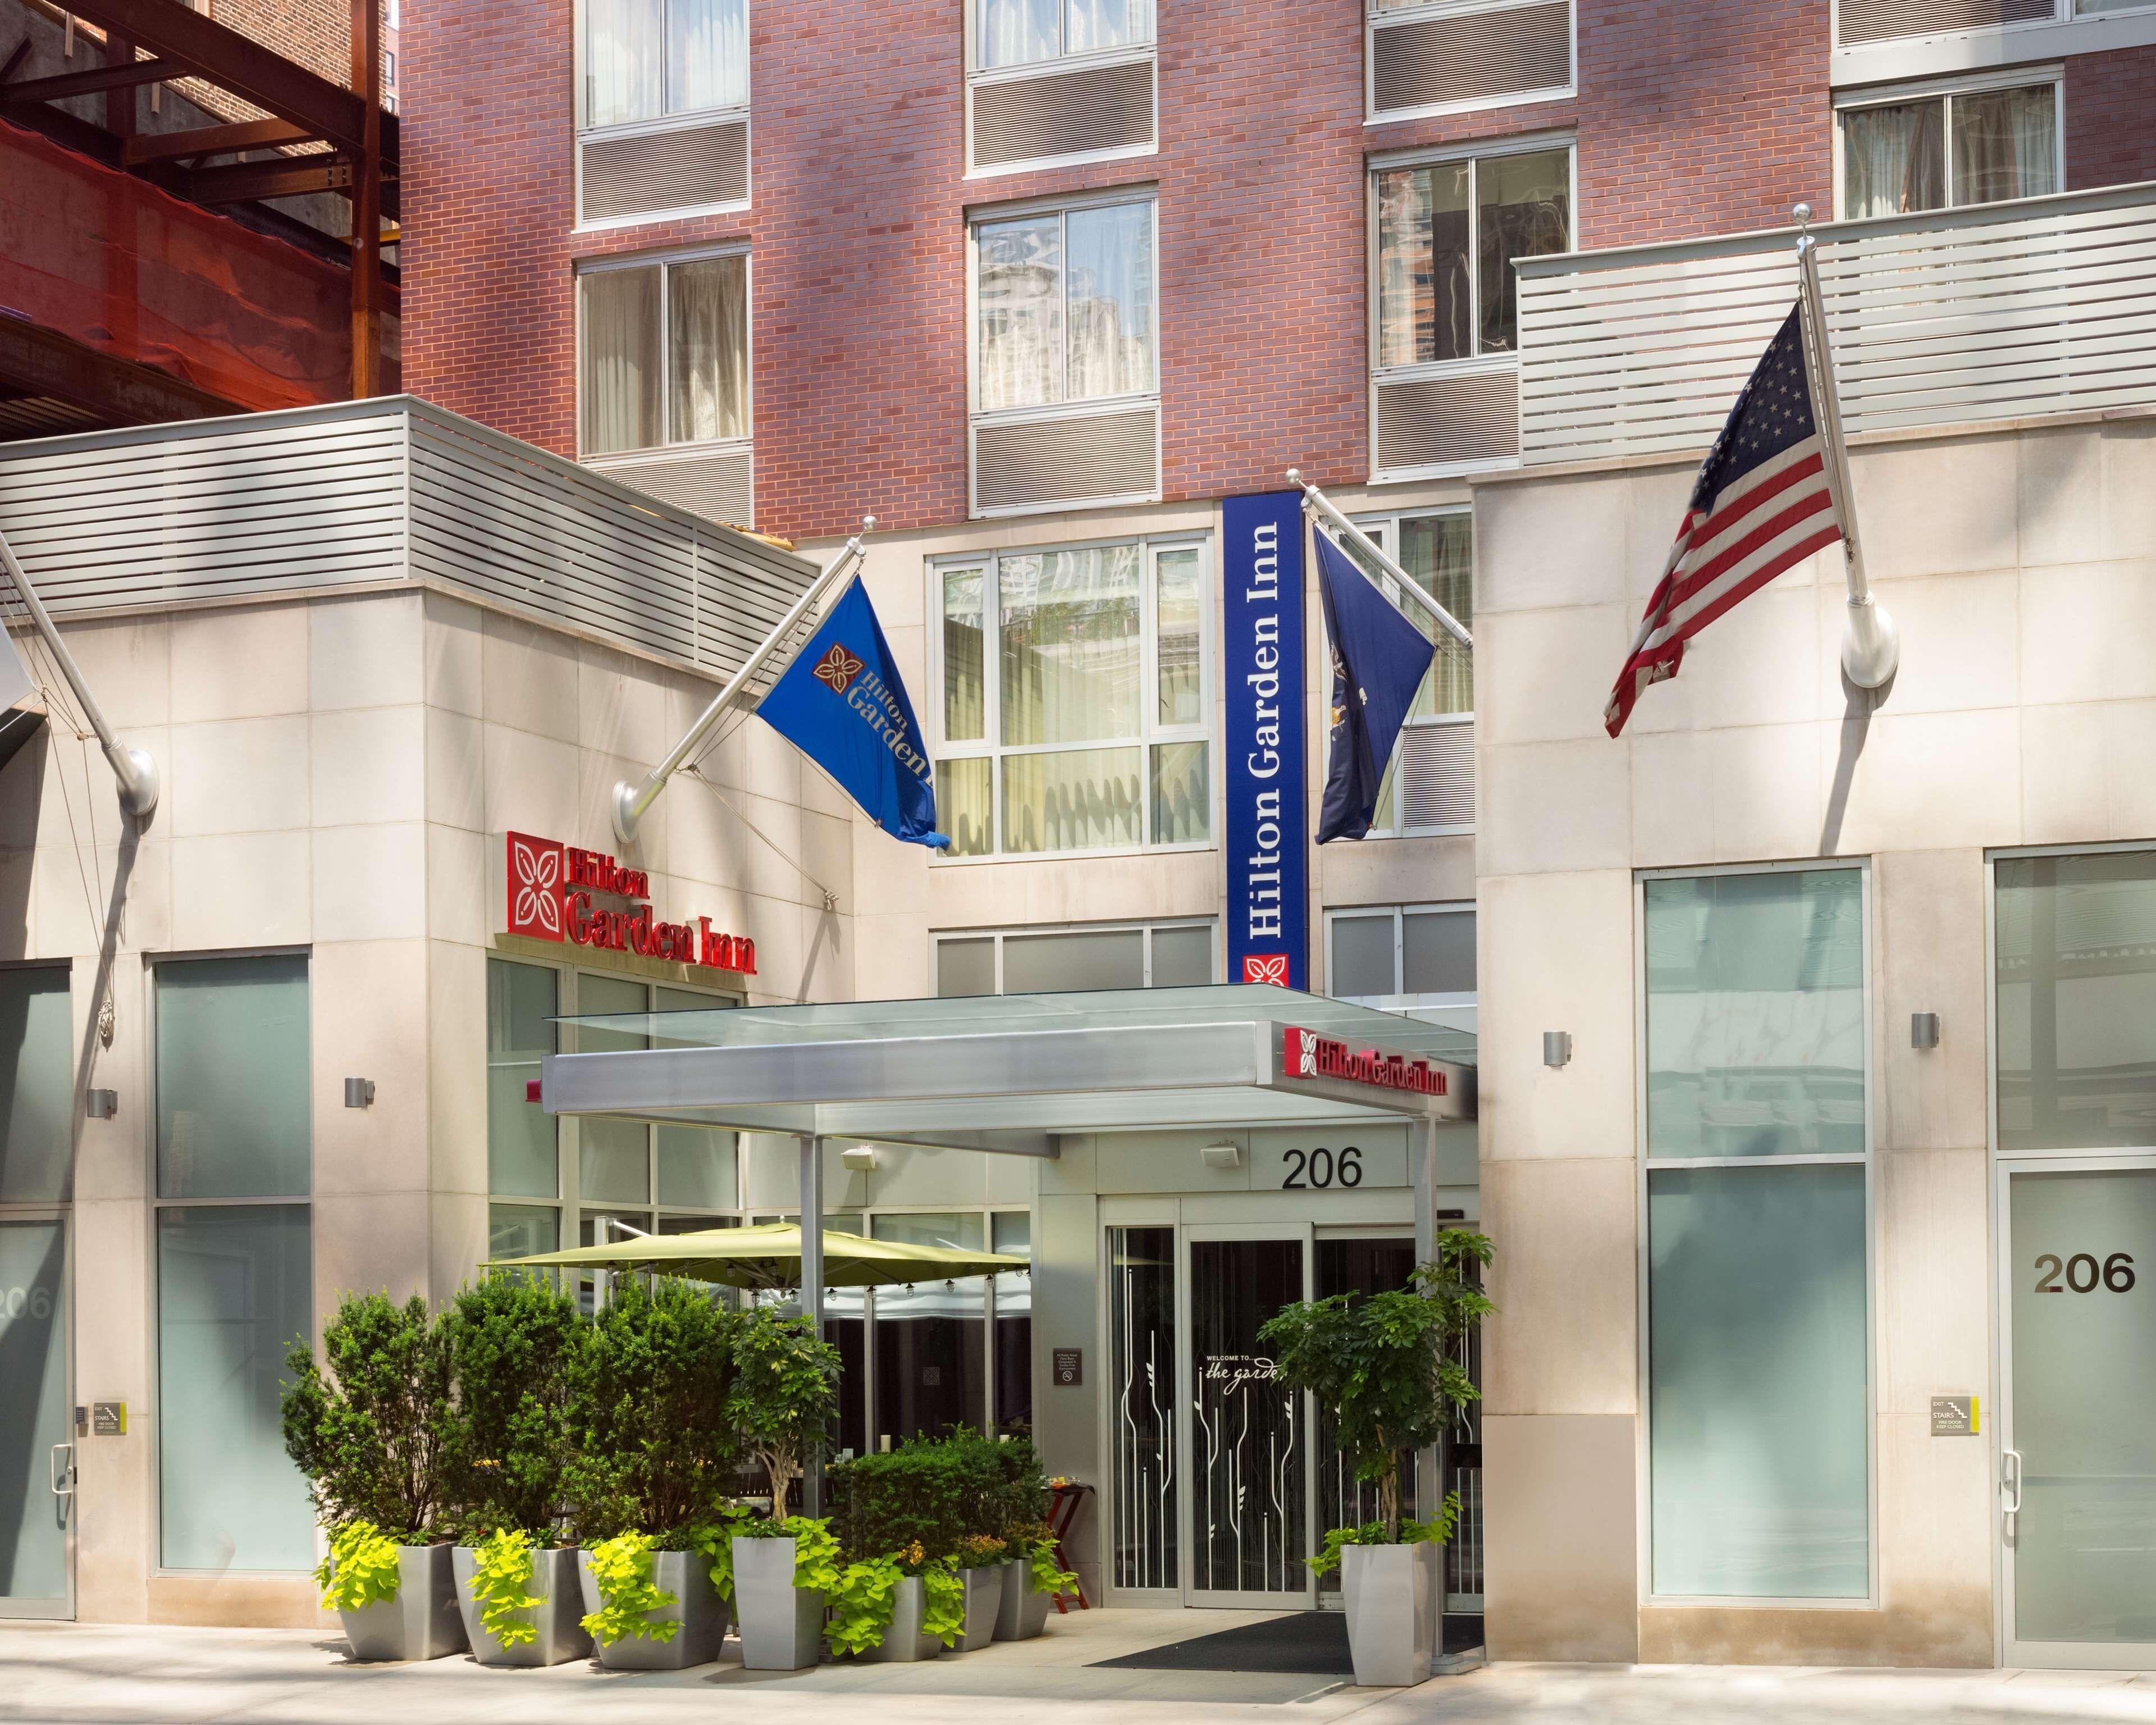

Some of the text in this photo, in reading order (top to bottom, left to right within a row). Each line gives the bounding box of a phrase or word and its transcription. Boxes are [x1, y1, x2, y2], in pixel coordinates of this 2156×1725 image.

[860, 670, 908, 730] Hilton
[847, 686, 926, 777] Garden
[1246, 521, 1281, 939] Hilton Garden Inn
[567, 846, 650, 900] Hilton
[567, 891, 758, 975] Garden Inn
[1317, 1038, 1448, 1095] Hilton Garden Inn
[1282, 1146, 1363, 1189] 206
[2034, 1253, 2136, 1294] 206
[0, 1287, 51, 1320] 06
[1205, 1362, 1231, 1379] the
